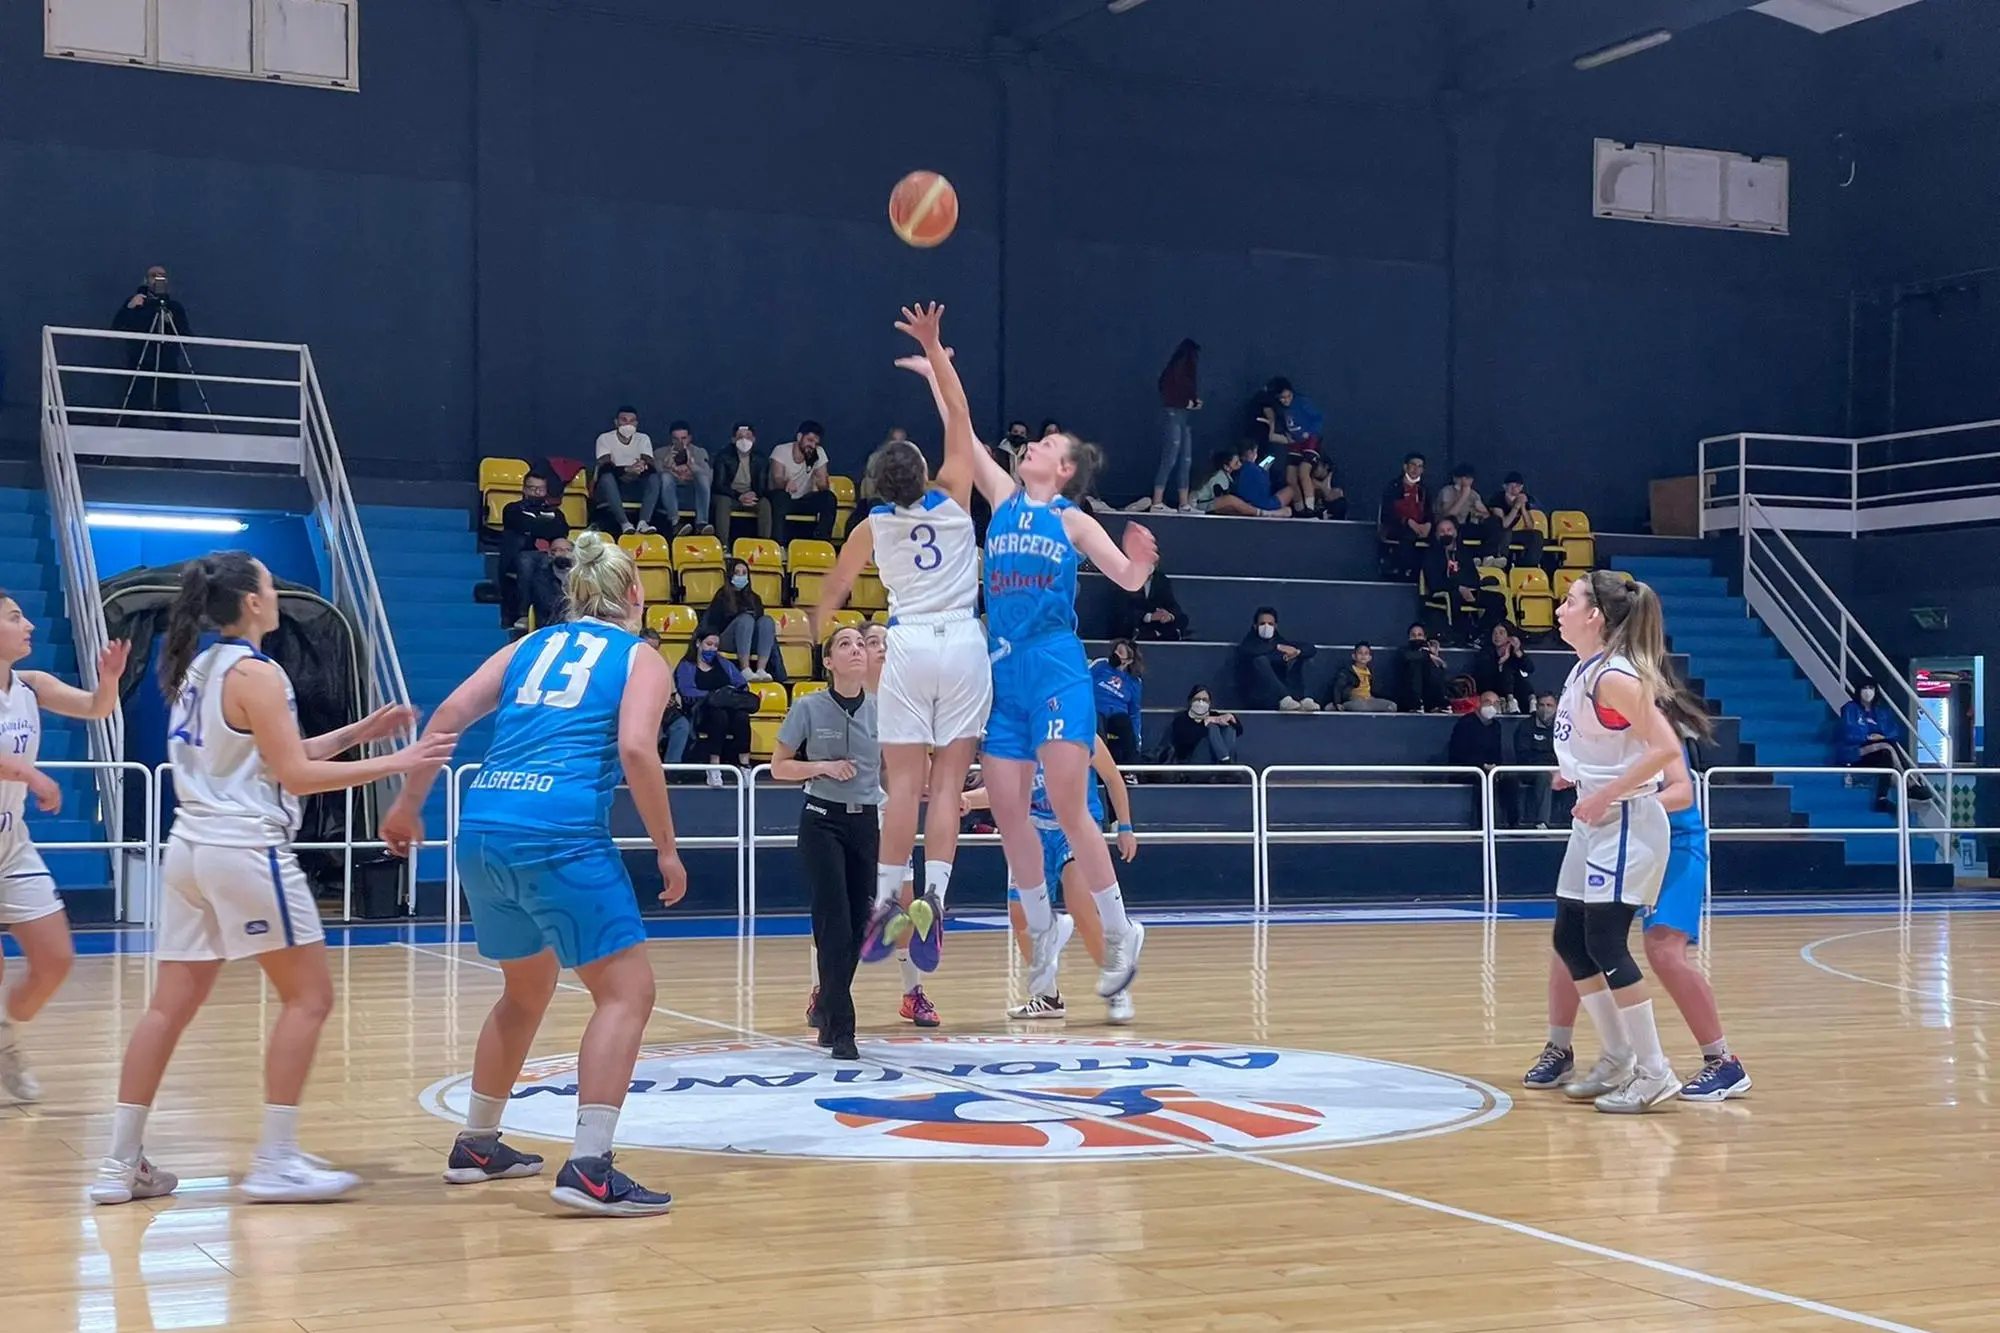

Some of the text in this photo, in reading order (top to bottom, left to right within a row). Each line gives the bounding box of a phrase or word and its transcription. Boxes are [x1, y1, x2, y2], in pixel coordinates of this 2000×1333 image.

[1018, 511, 1033, 530] 12
[910, 523, 942, 571] 3
[988, 532, 1068, 564] MERCEDE
[515, 631, 608, 709] 13
[1047, 718, 1064, 739] 12
[1554, 721, 1572, 742] 23
[13, 734, 28, 753] 17
[470, 770, 554, 792] ALGHERO
